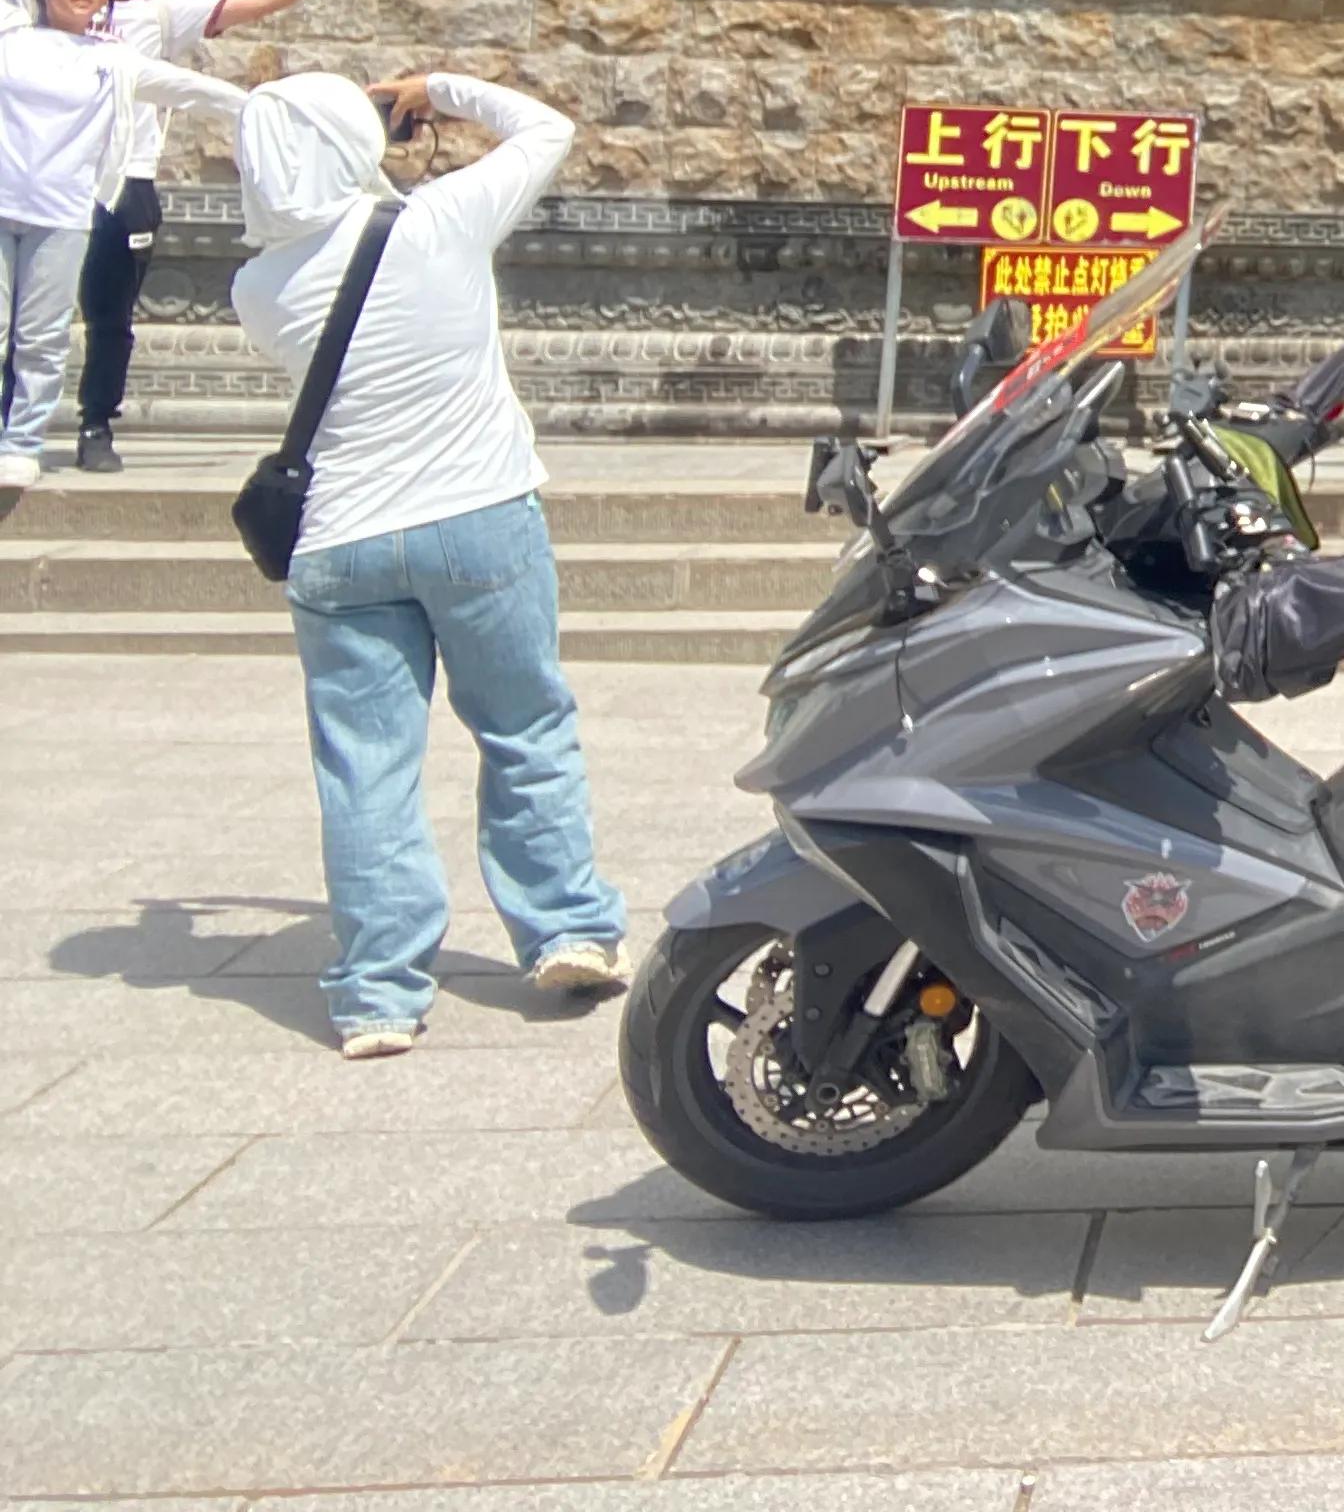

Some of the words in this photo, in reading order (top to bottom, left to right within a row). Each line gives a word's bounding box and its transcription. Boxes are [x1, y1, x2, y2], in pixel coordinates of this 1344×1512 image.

[905, 111, 1042, 170] 上行
[1060, 118, 1191, 176] 下行
[923, 172, 1015, 192] Upstream
[1099, 181, 1152, 199] Down
